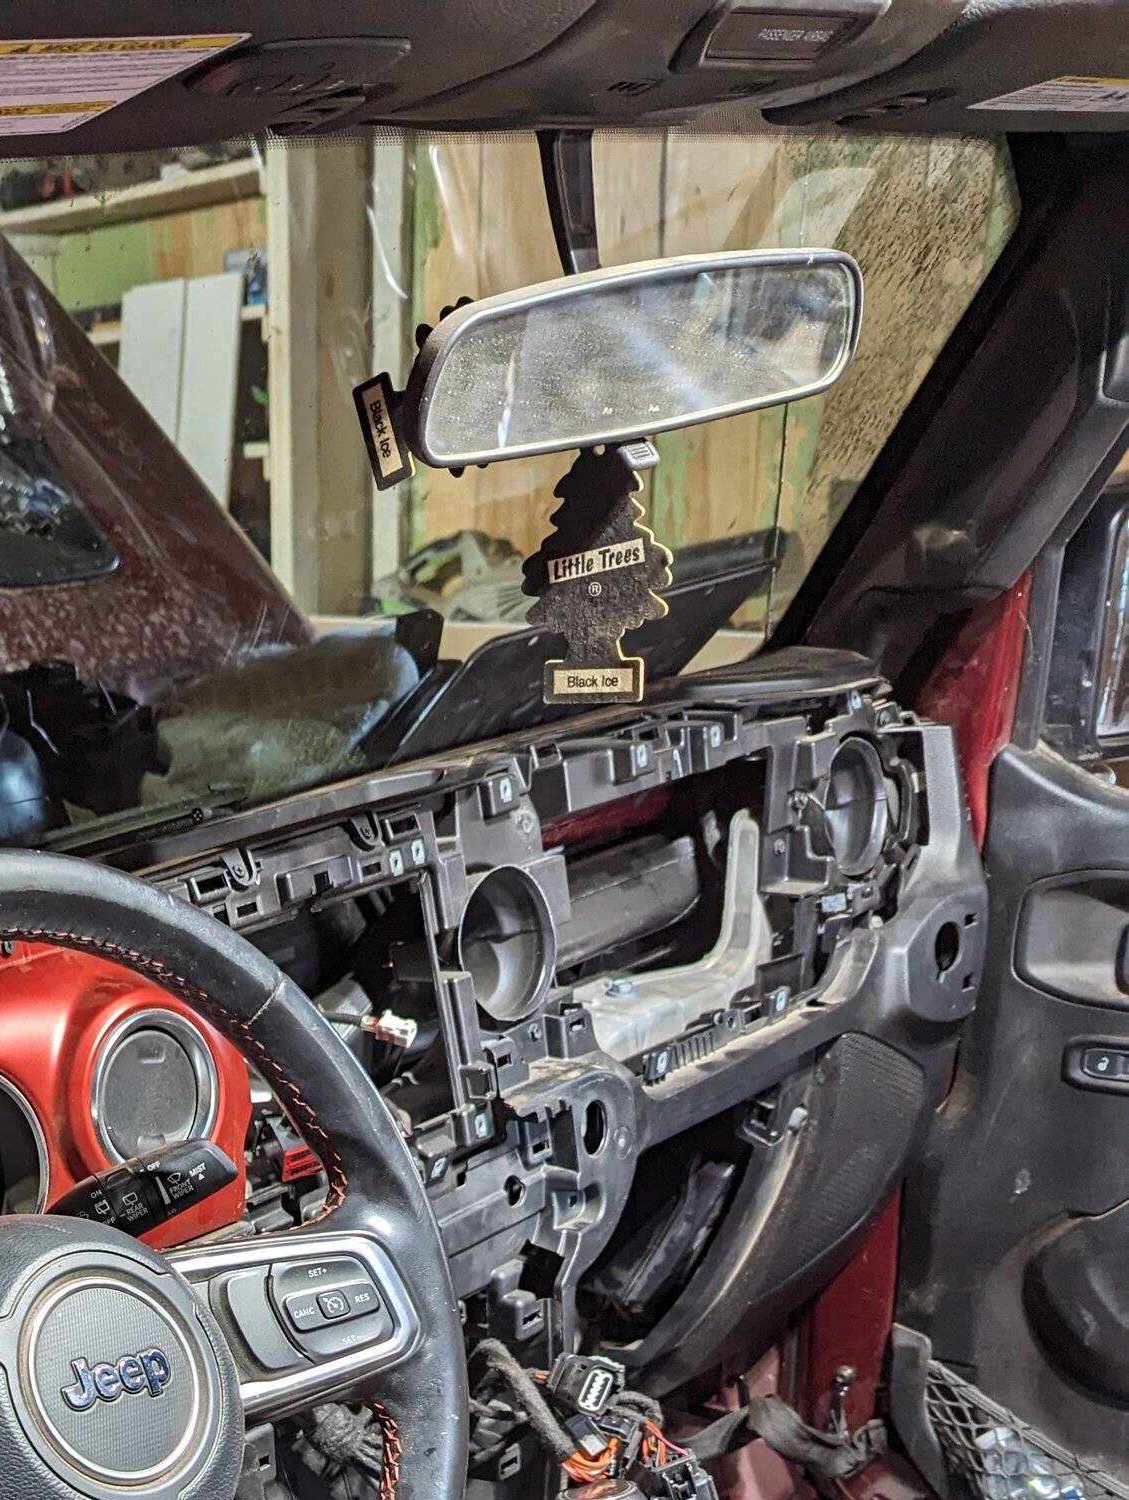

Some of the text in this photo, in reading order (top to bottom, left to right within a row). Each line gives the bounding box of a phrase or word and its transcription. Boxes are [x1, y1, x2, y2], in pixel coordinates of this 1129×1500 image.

[370, 400, 391, 459] Black Ice
[553, 547, 640, 581] Little Trees
[567, 675, 619, 688] Black Ice
[147, 1160, 161, 1172] OFF
[188, 1162, 207, 1178] MIST
[169, 1178, 191, 1194] FRONT
[171, 1185, 194, 1200] WIPER
[90, 1189, 103, 1199] ON
[125, 1202, 144, 1216] REAR
[126, 1207, 149, 1222] WIPER
[354, 1293, 371, 1304] RES
[293, 1306, 316, 1319] CANC
[60, 1348, 171, 1412] Jeep
